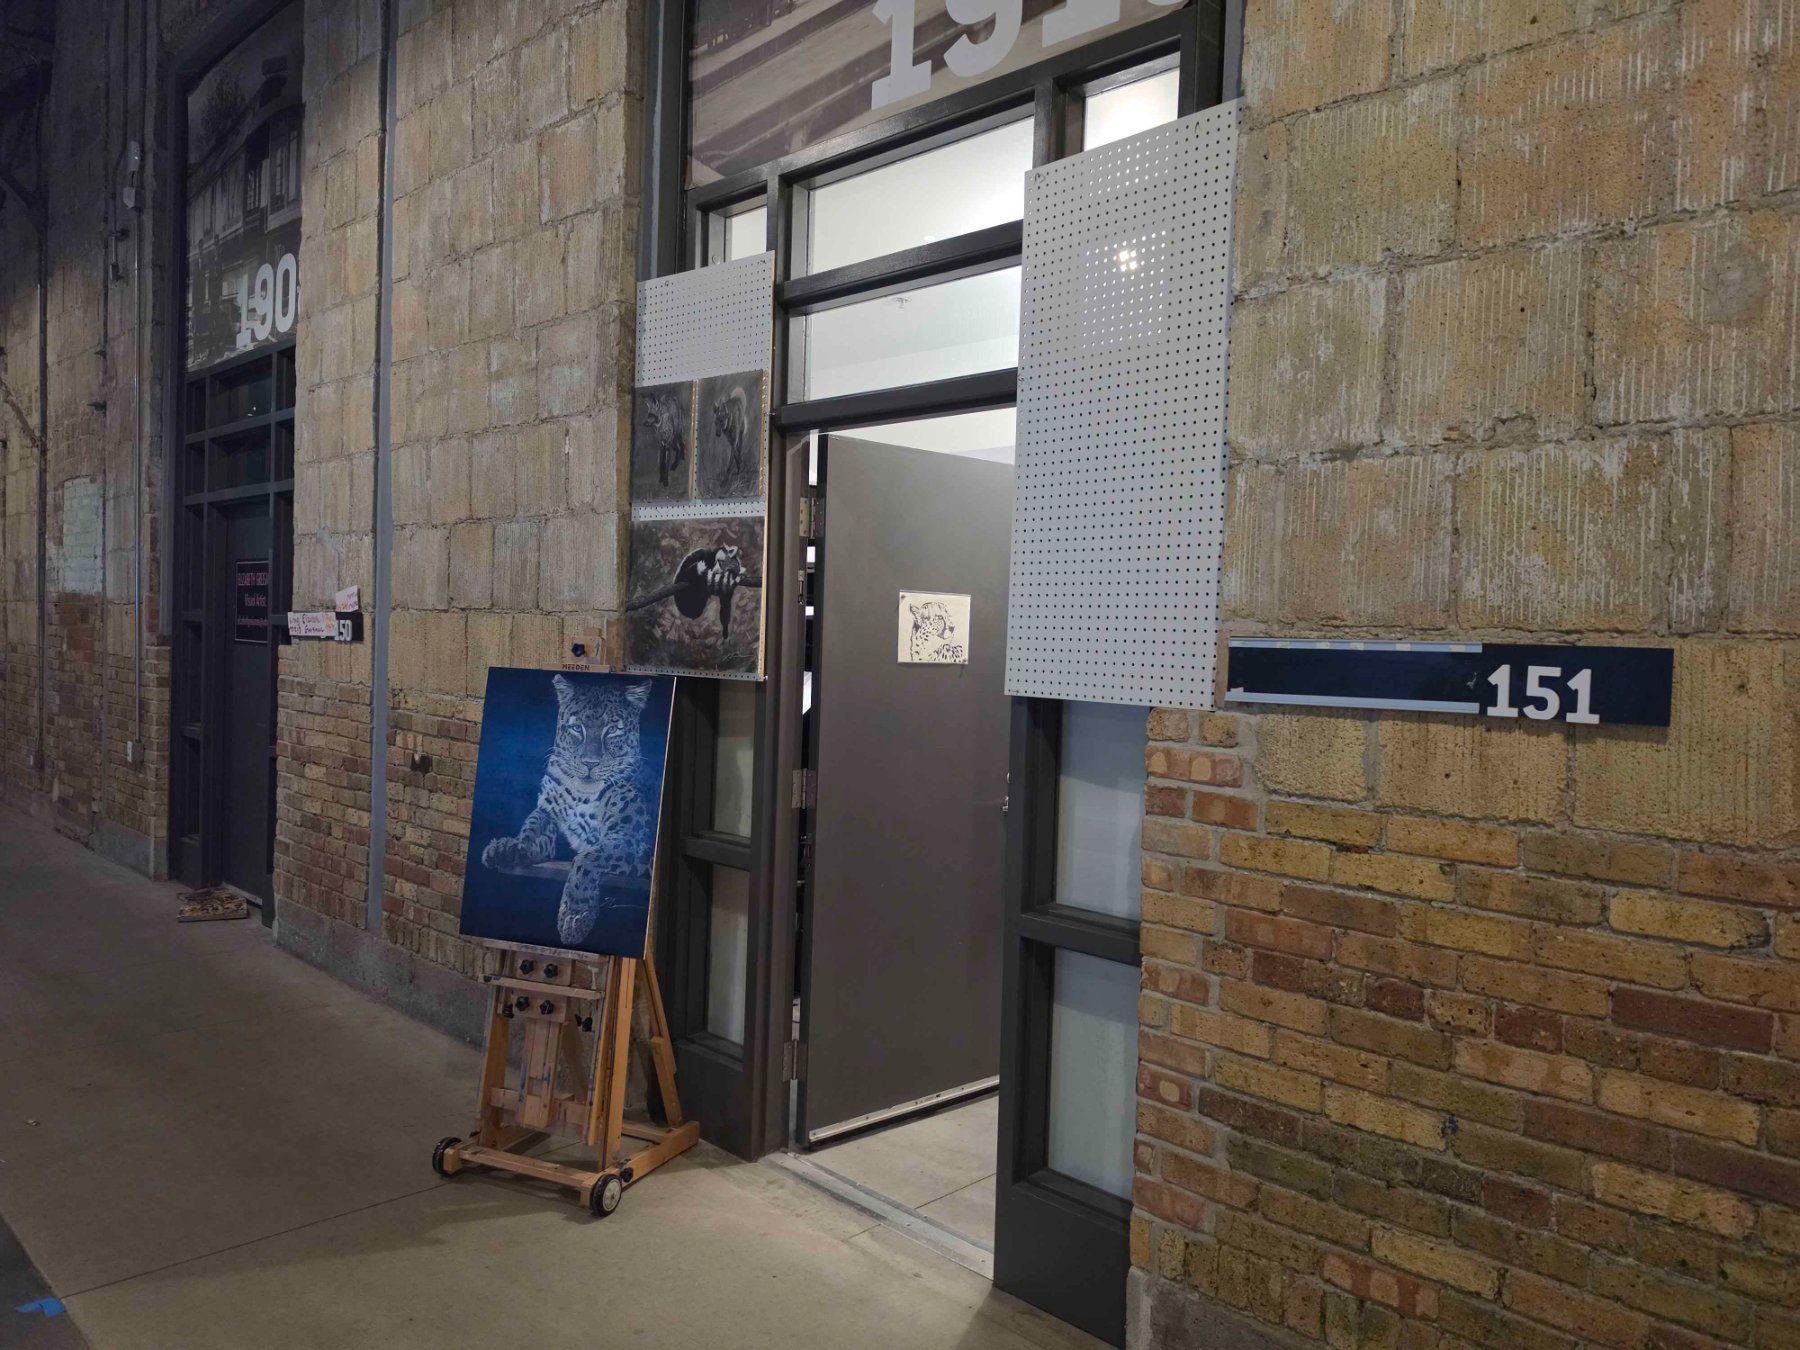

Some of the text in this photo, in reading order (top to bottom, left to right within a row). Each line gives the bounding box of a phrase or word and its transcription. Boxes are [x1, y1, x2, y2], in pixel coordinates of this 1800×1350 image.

[871, 0, 1190, 110] 19
[561, 663, 590, 671] MEEDEN
[1487, 664, 1600, 724] 151
